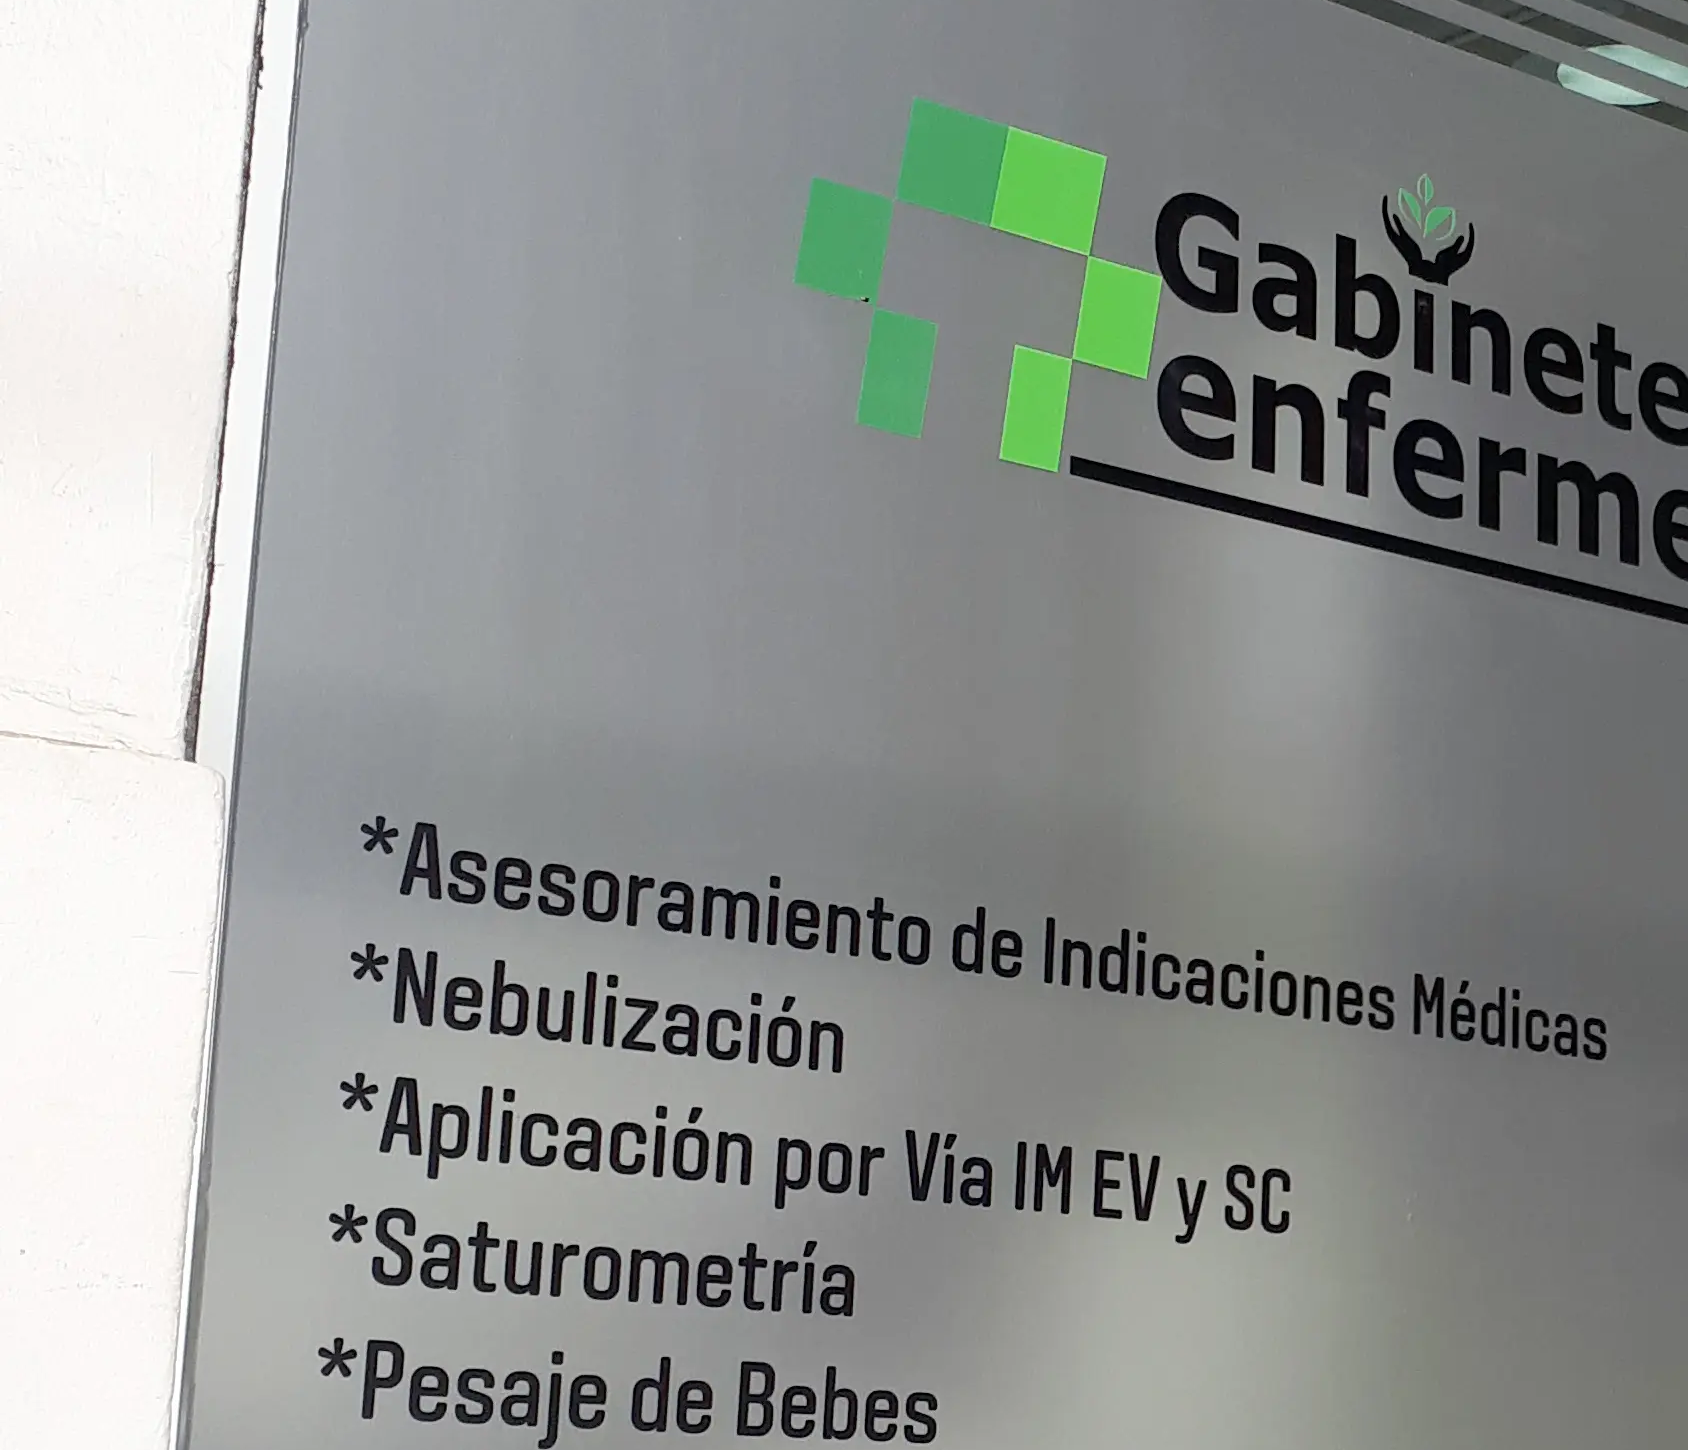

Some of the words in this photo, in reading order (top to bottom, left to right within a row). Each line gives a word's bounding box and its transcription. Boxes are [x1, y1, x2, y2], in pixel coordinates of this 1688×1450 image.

[952, 907, 1023, 978] de
[1044, 917, 1395, 1031] Indicaciones
[1414, 974, 1607, 1060] Médicas
[774, 1137, 885, 1209] por
[905, 1129, 993, 1208] Vía
[1014, 1141, 1073, 1215] IM
[1093, 1150, 1160, 1221] EV
[1175, 1177, 1207, 1244] y
[1224, 1165, 1291, 1234] SC
[631, 1357, 713, 1434] de
[737, 1361, 939, 1445] Bebes
